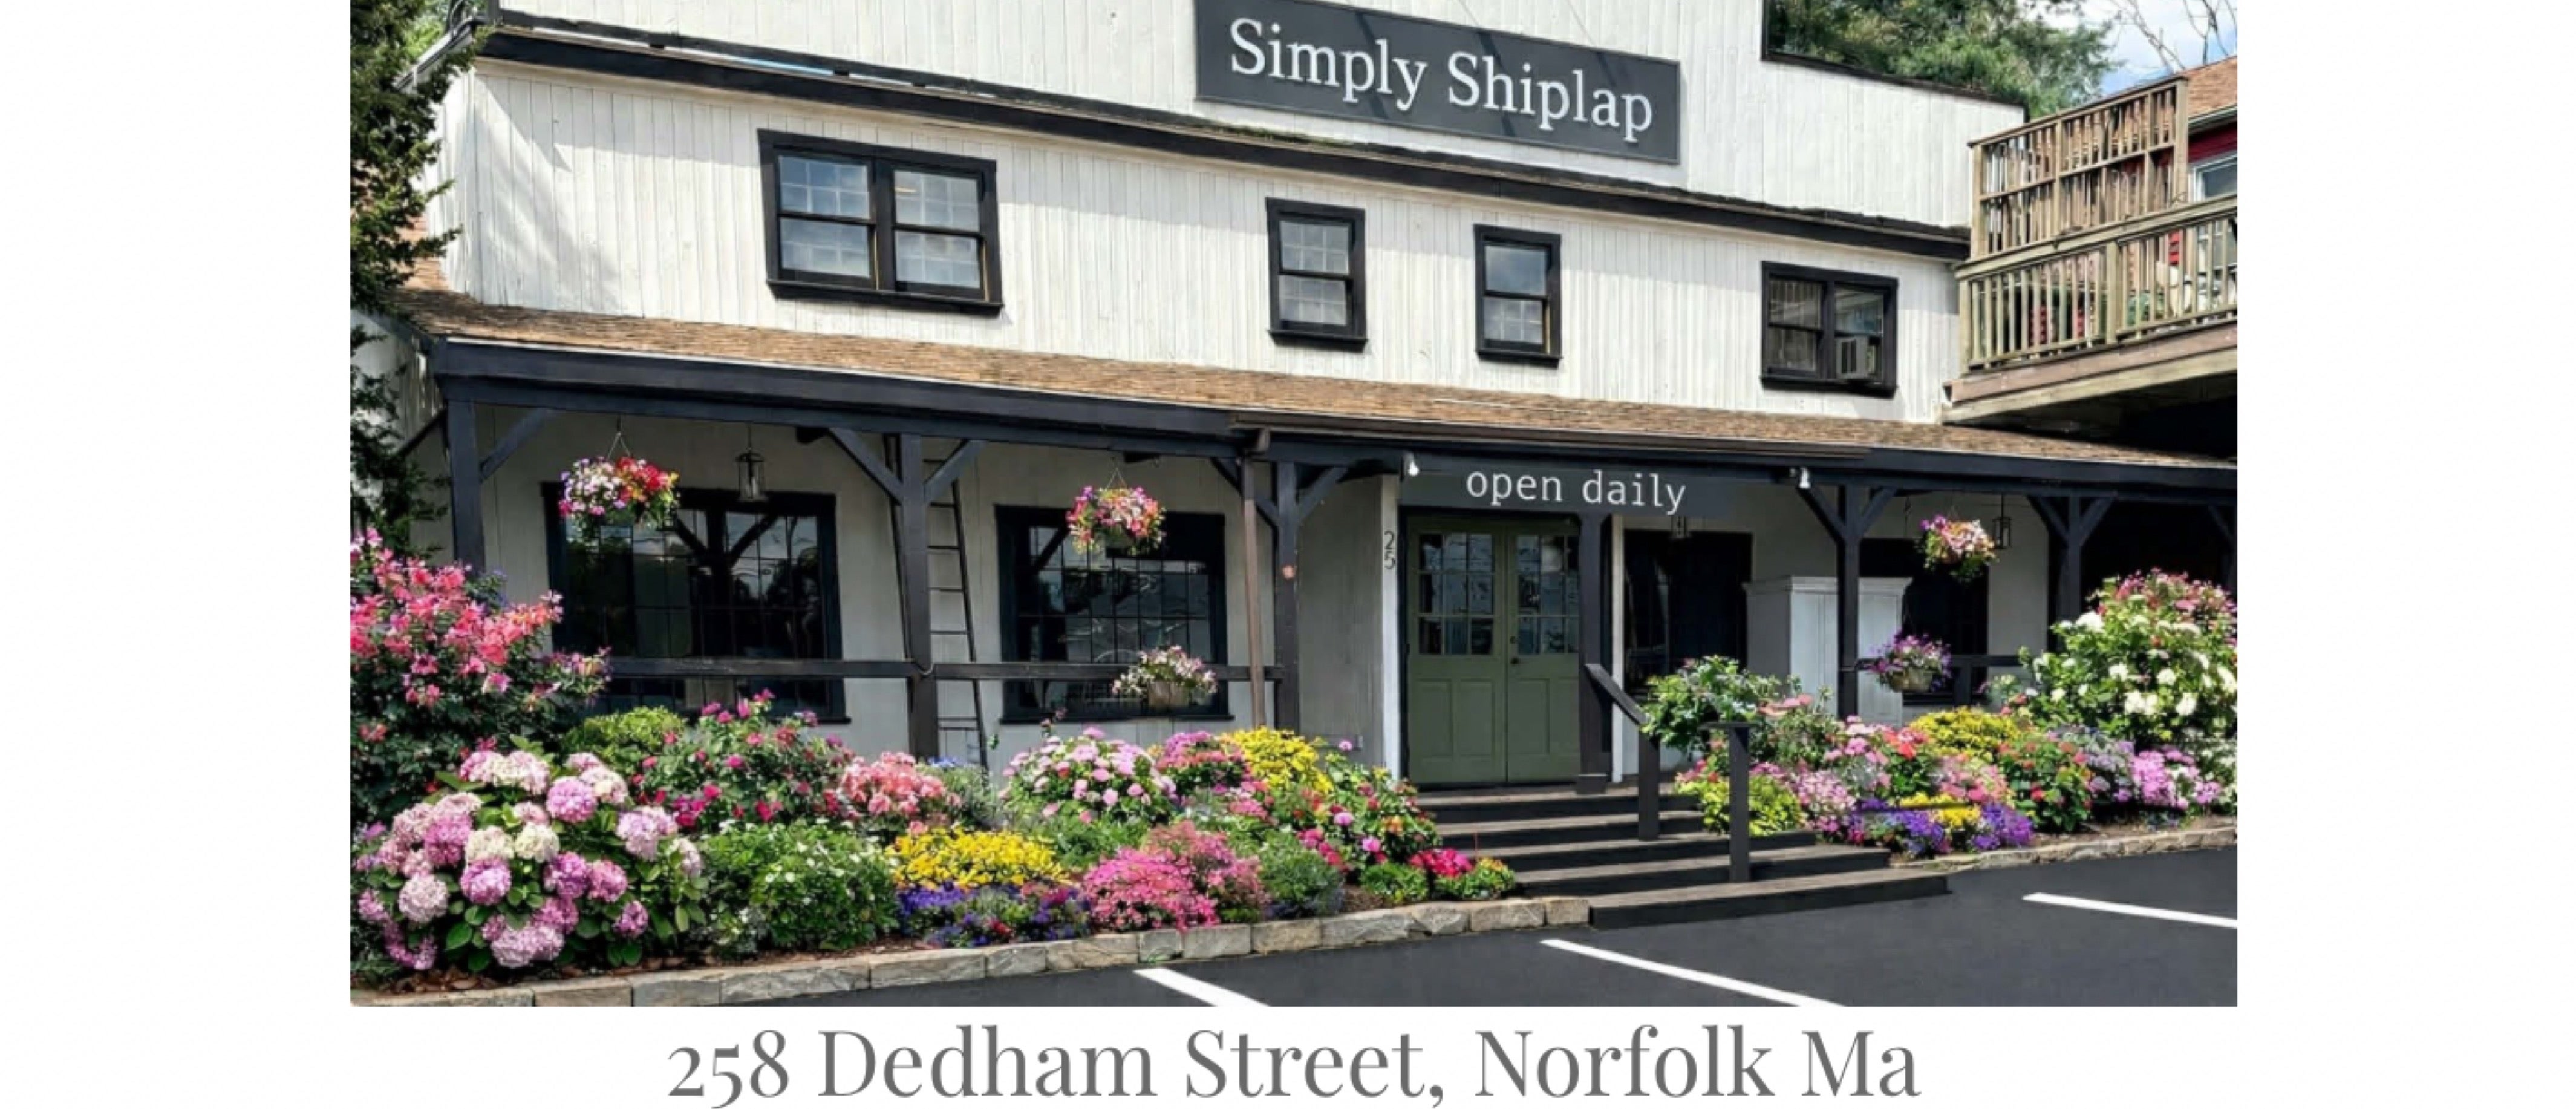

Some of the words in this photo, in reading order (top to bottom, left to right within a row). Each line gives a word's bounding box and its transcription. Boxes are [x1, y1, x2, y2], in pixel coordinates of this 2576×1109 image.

[1230, 17, 1427, 111] Simply
[1447, 51, 1652, 143] Shiplap
[1466, 470, 1564, 506] open
[1582, 469, 1686, 515] daily
